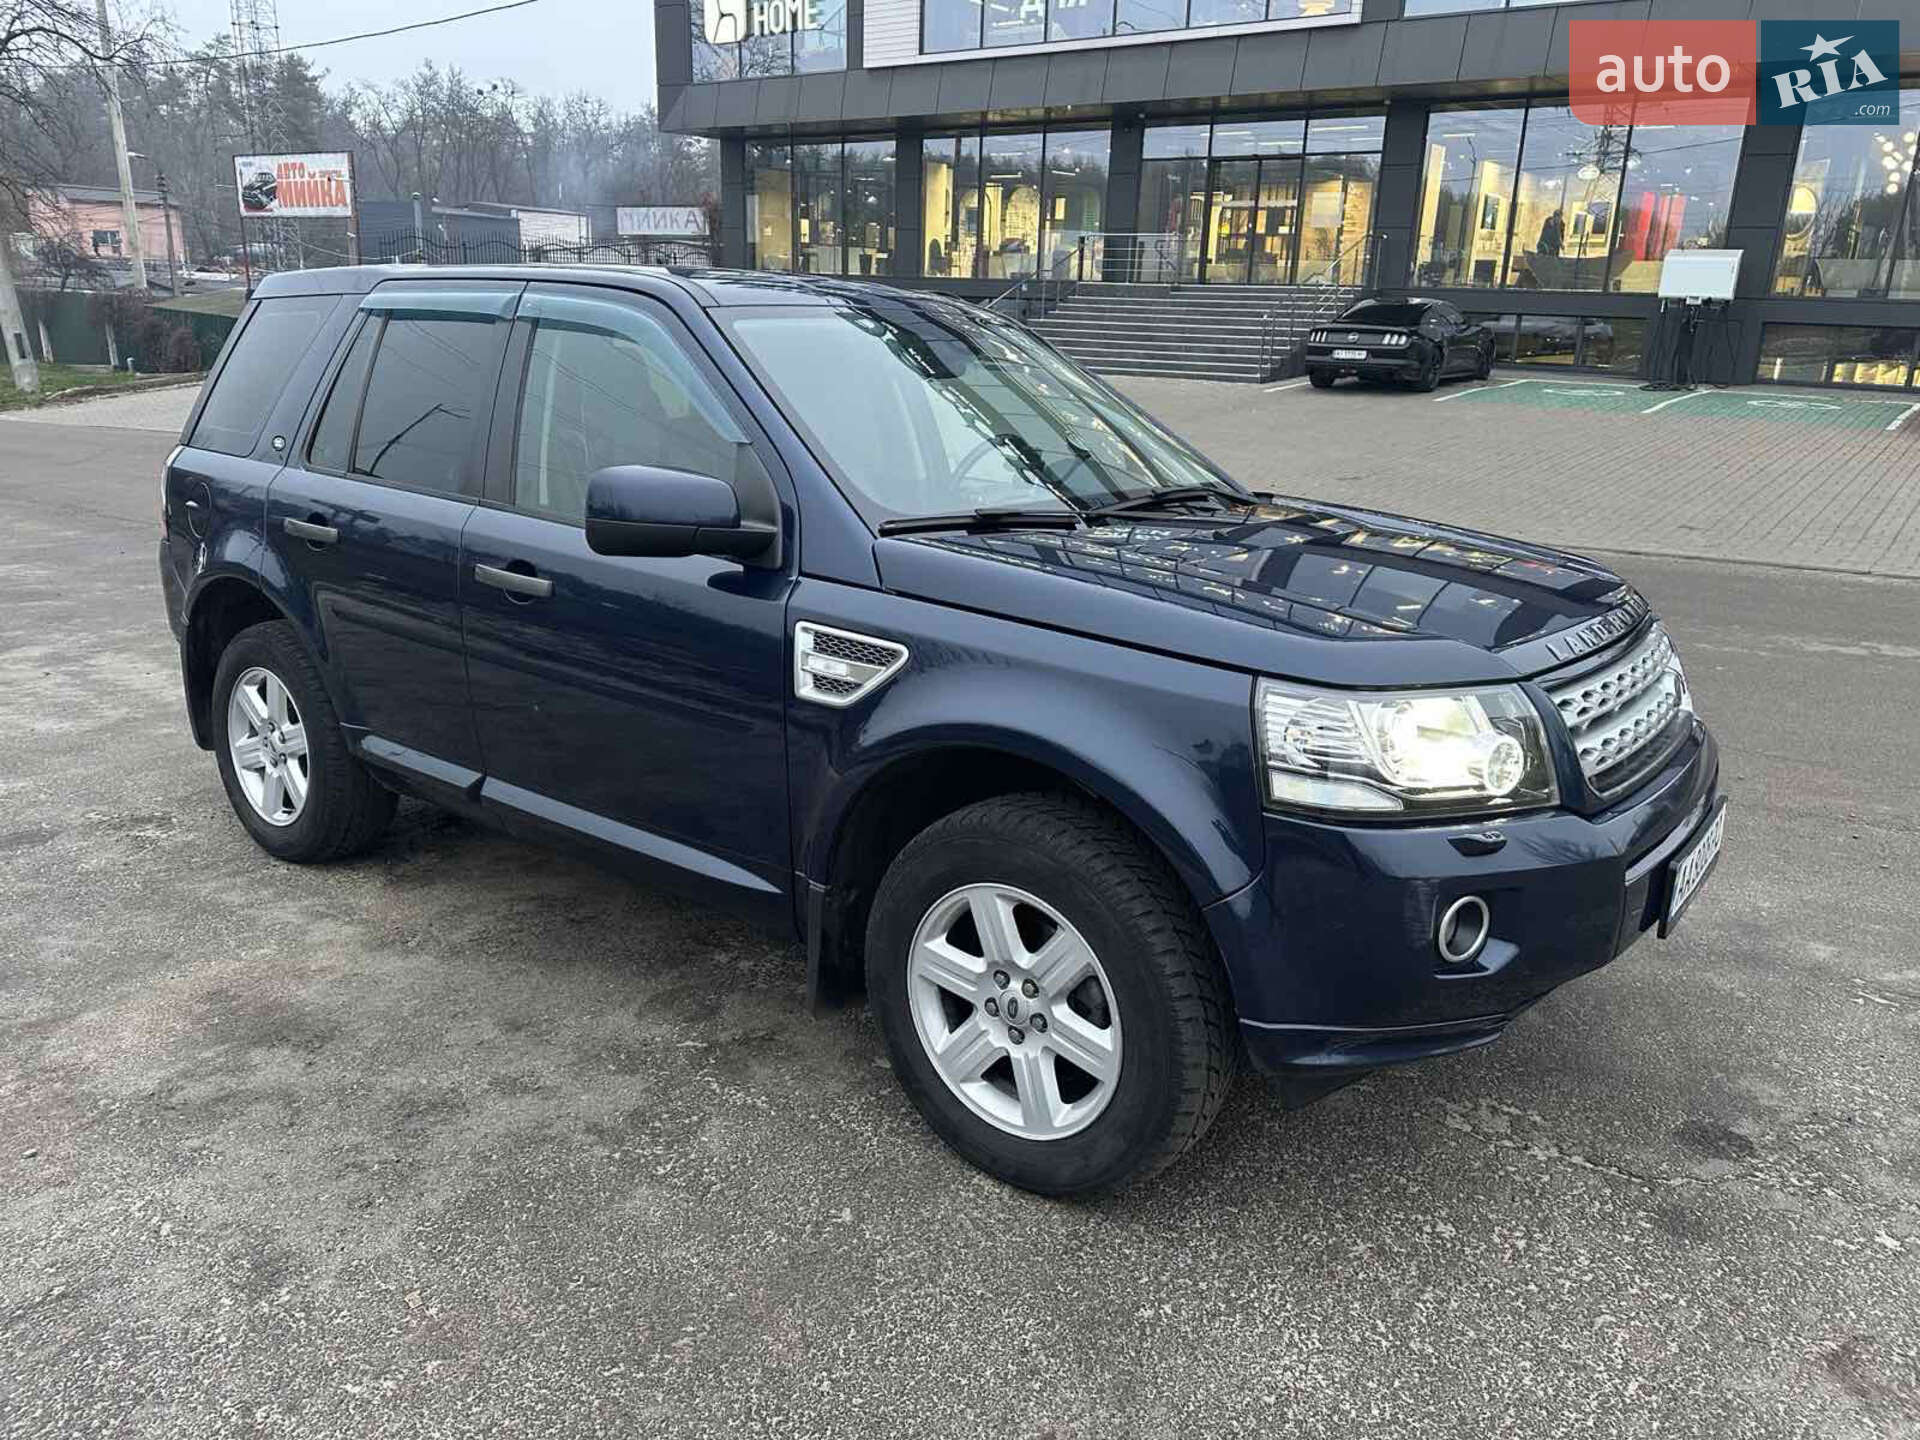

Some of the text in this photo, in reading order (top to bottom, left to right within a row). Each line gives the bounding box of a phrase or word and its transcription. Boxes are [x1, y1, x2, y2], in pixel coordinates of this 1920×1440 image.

[752, 0, 823, 37] HOME
[277, 162, 306, 180] АВТО
[1544, 620, 1609, 662] LAND
